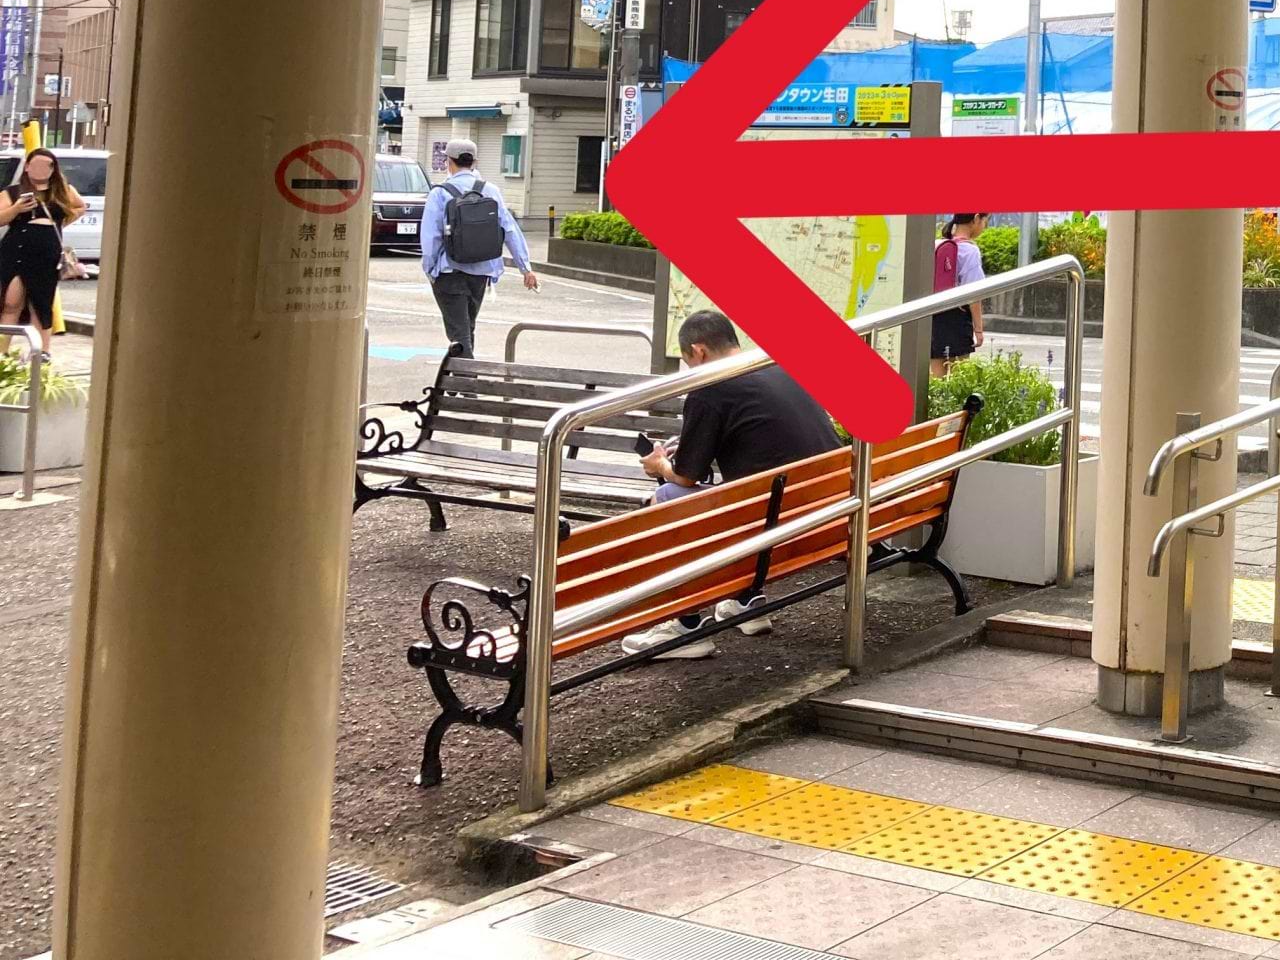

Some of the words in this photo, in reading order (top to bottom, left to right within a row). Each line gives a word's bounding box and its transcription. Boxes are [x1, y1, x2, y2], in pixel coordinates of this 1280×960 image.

[299, 223, 347, 241] 禁煙
[290, 247, 308, 259] No
[311, 247, 350, 261] Smoking
